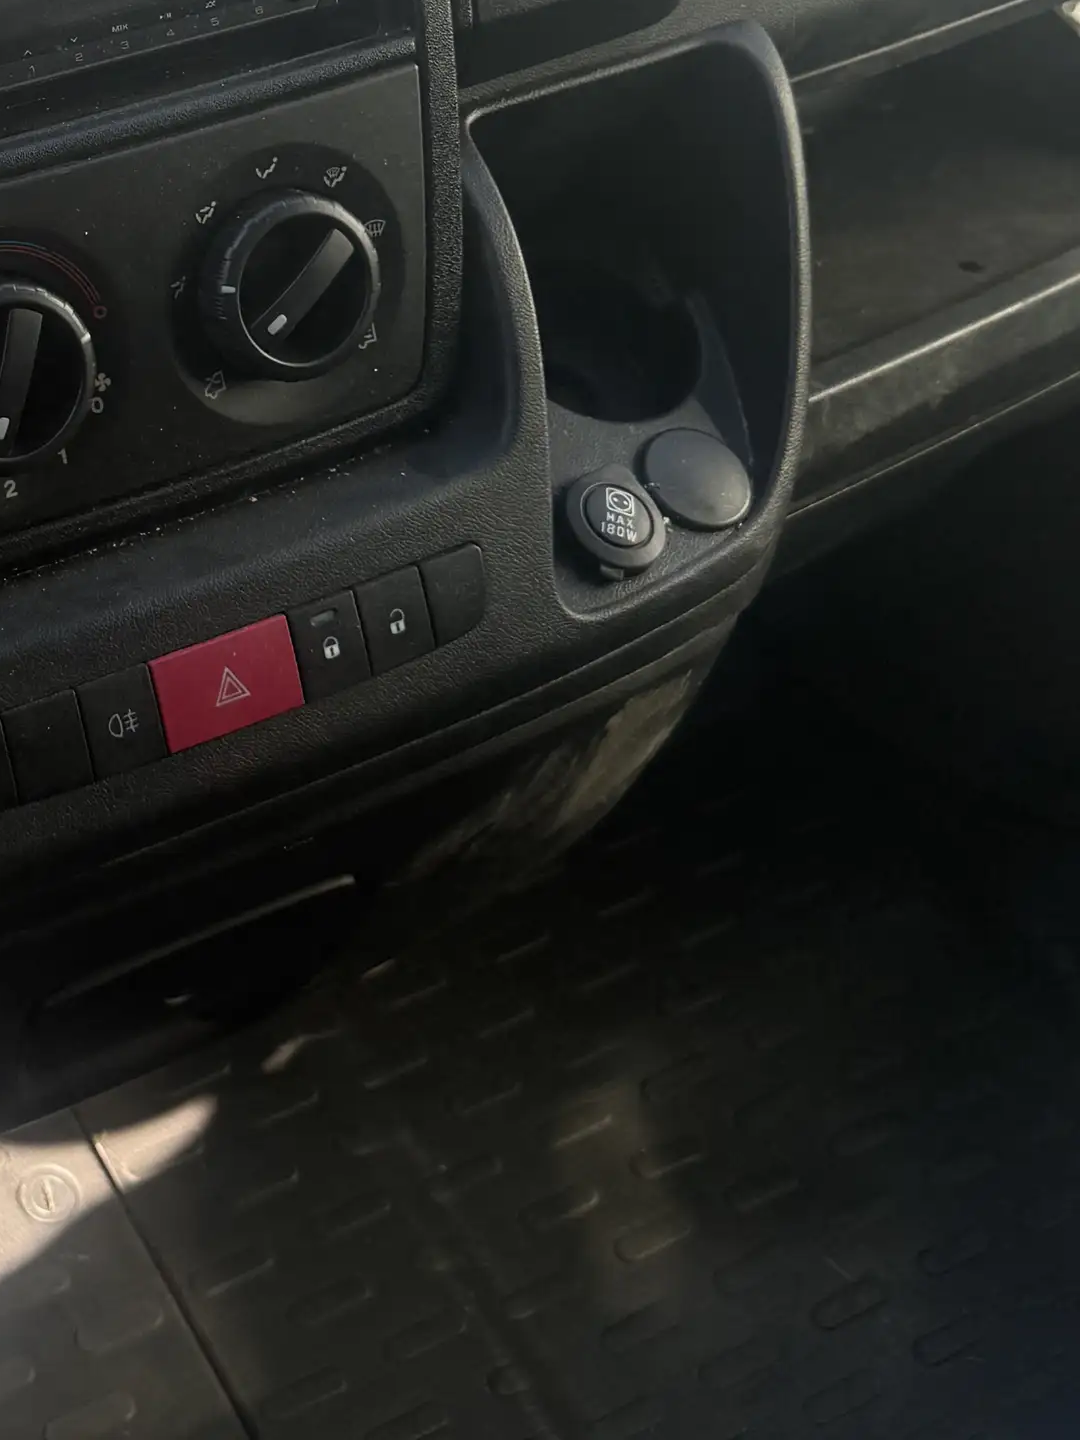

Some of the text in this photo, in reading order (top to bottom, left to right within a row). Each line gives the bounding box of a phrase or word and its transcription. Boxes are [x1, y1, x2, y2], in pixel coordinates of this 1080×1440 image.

[210, 17, 219, 27] 5
[120, 40, 130, 50] 3
[75, 52, 83, 62] 2
[89, 396, 104, 414] 0
[57, 448, 68, 465] 1
[3, 480, 18, 499] 2
[606, 512, 635, 529] MAX
[600, 522, 638, 542] 180W
